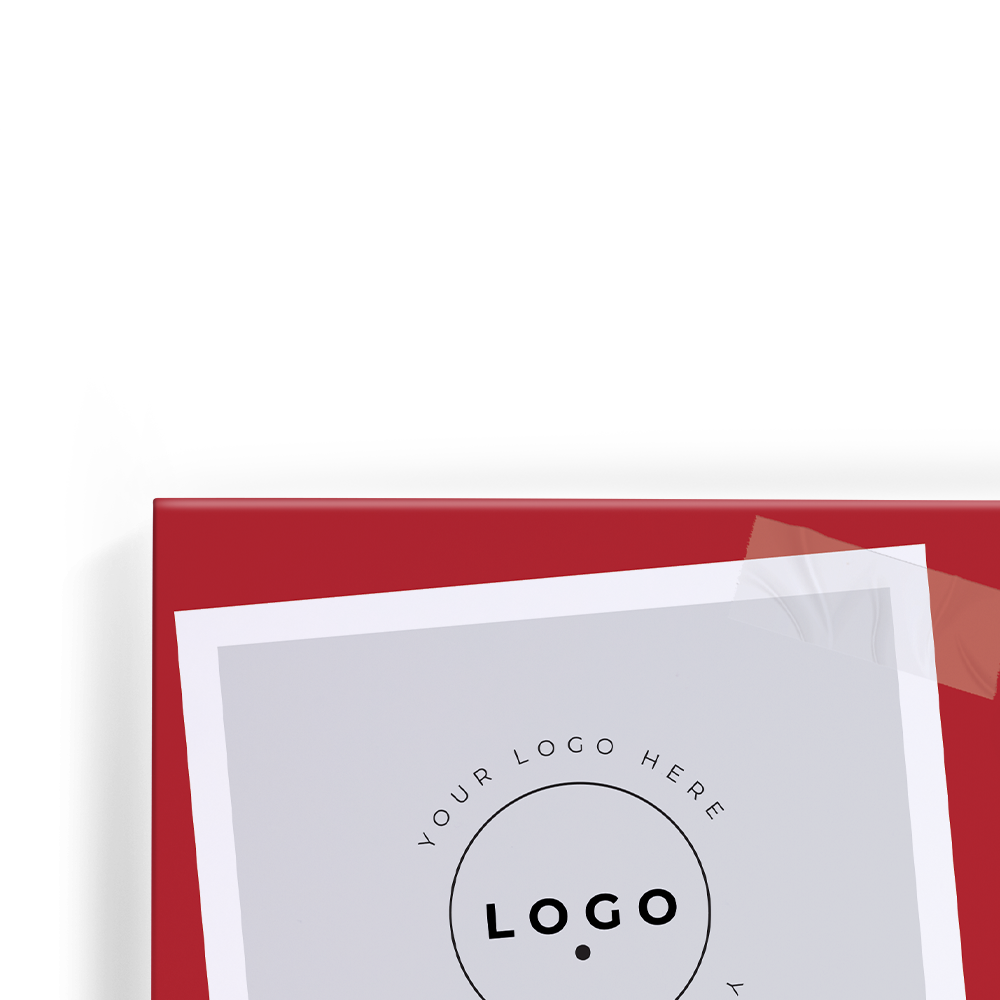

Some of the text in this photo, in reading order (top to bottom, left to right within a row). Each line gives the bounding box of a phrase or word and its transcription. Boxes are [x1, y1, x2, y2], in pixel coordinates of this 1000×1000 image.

[418, 737, 724, 845] YOUR LOGO HERE
[486, 889, 677, 939] LOGO
